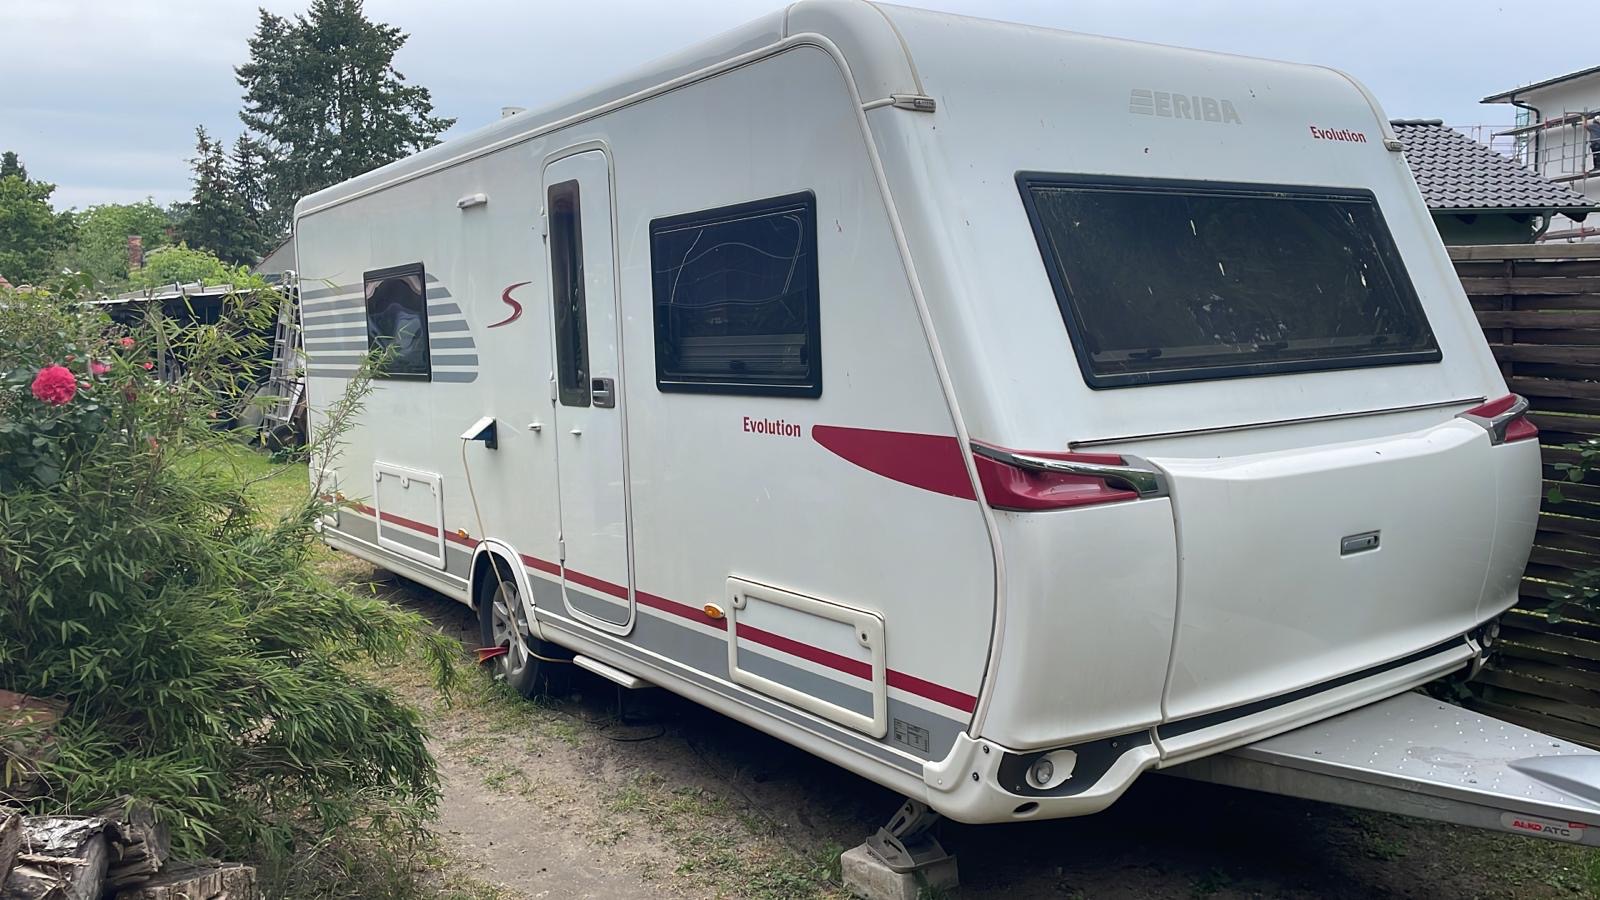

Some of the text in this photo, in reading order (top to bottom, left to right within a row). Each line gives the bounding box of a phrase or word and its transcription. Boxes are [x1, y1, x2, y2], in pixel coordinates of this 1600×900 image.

[1153, 91, 1242, 125] ERIBA
[1310, 126, 1367, 143] Evolution
[743, 416, 801, 437] Evolution
[1543, 826, 1570, 837] ATC
